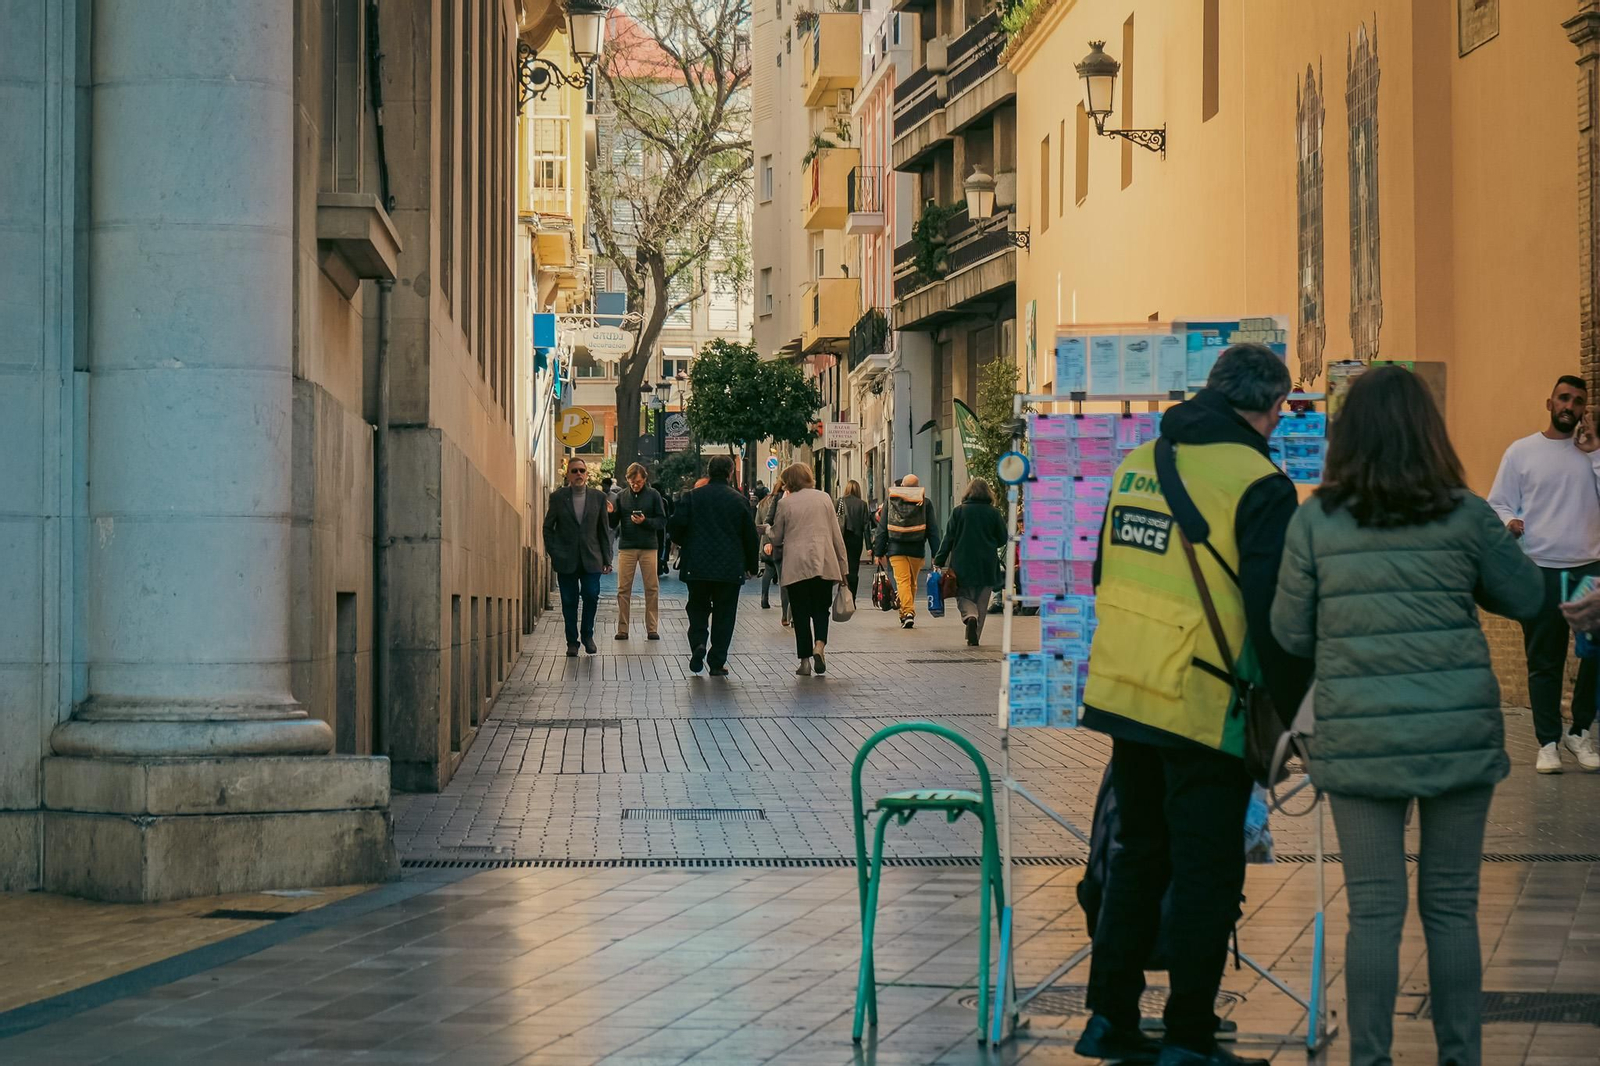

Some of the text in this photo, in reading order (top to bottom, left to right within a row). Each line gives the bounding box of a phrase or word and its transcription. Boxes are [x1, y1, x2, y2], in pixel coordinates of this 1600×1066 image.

[562, 413, 580, 434] P
[1122, 513, 1169, 529] grupo social
[1121, 524, 1167, 550] ONCE
